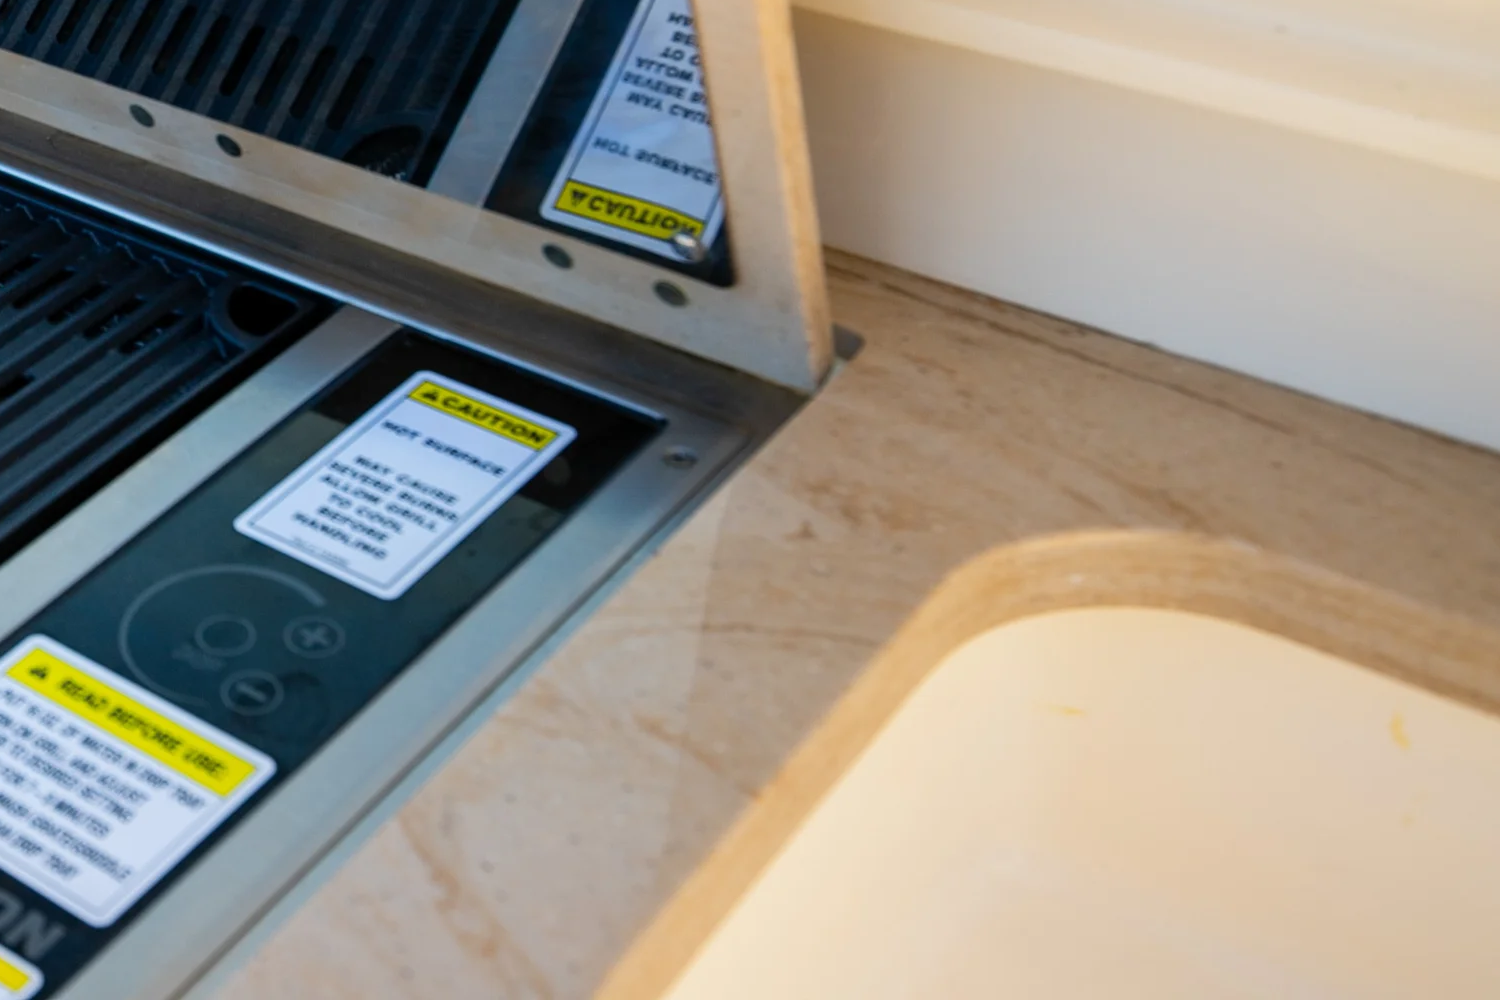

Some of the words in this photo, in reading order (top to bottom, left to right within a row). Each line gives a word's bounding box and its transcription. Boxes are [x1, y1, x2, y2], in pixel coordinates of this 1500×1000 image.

[437, 395, 549, 444] CAUTION
[378, 421, 419, 441] HOT
[421, 438, 507, 475] SURFACE
[53, 678, 110, 713] READ
[104, 705, 185, 754] BEFORE
